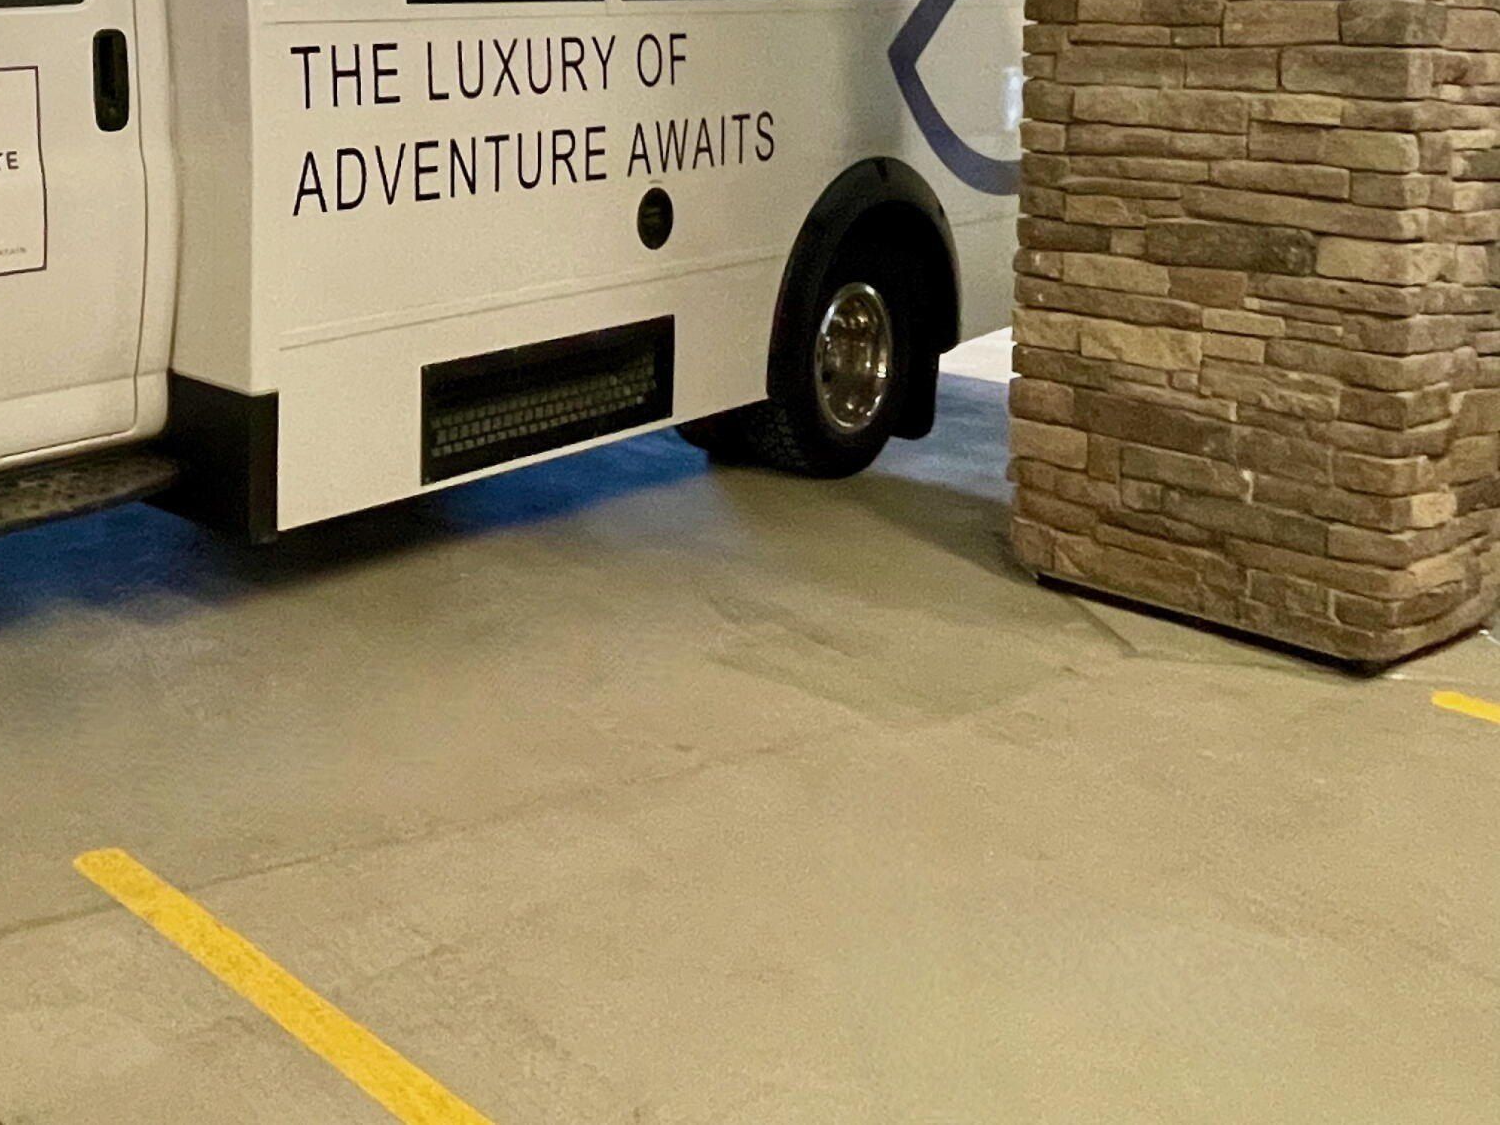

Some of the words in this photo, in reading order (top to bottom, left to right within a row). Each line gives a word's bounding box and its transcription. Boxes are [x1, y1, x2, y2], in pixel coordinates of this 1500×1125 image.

[290, 42, 401, 110] THE
[427, 34, 616, 101] LUXURY
[636, 32, 687, 88] OF
[292, 125, 607, 217] ADVENTURE
[626, 110, 776, 177] AWAITS
